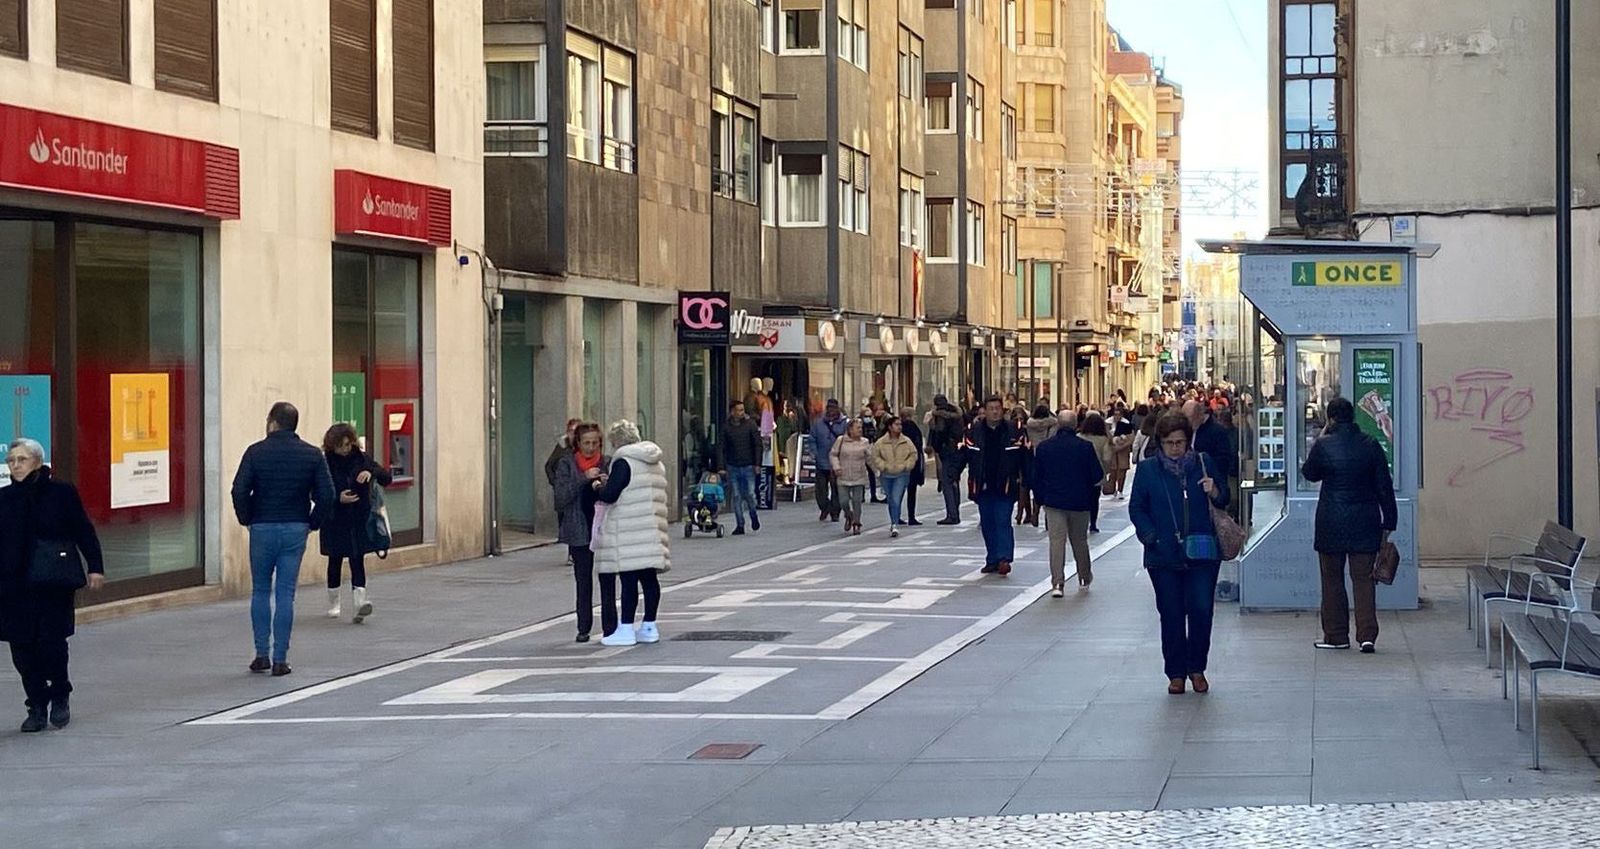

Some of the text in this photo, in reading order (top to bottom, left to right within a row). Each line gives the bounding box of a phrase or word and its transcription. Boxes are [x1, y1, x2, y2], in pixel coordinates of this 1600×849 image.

[52, 138, 128, 174] Santander
[375, 194, 419, 219] Santander
[1325, 264, 1393, 282] ONCE
